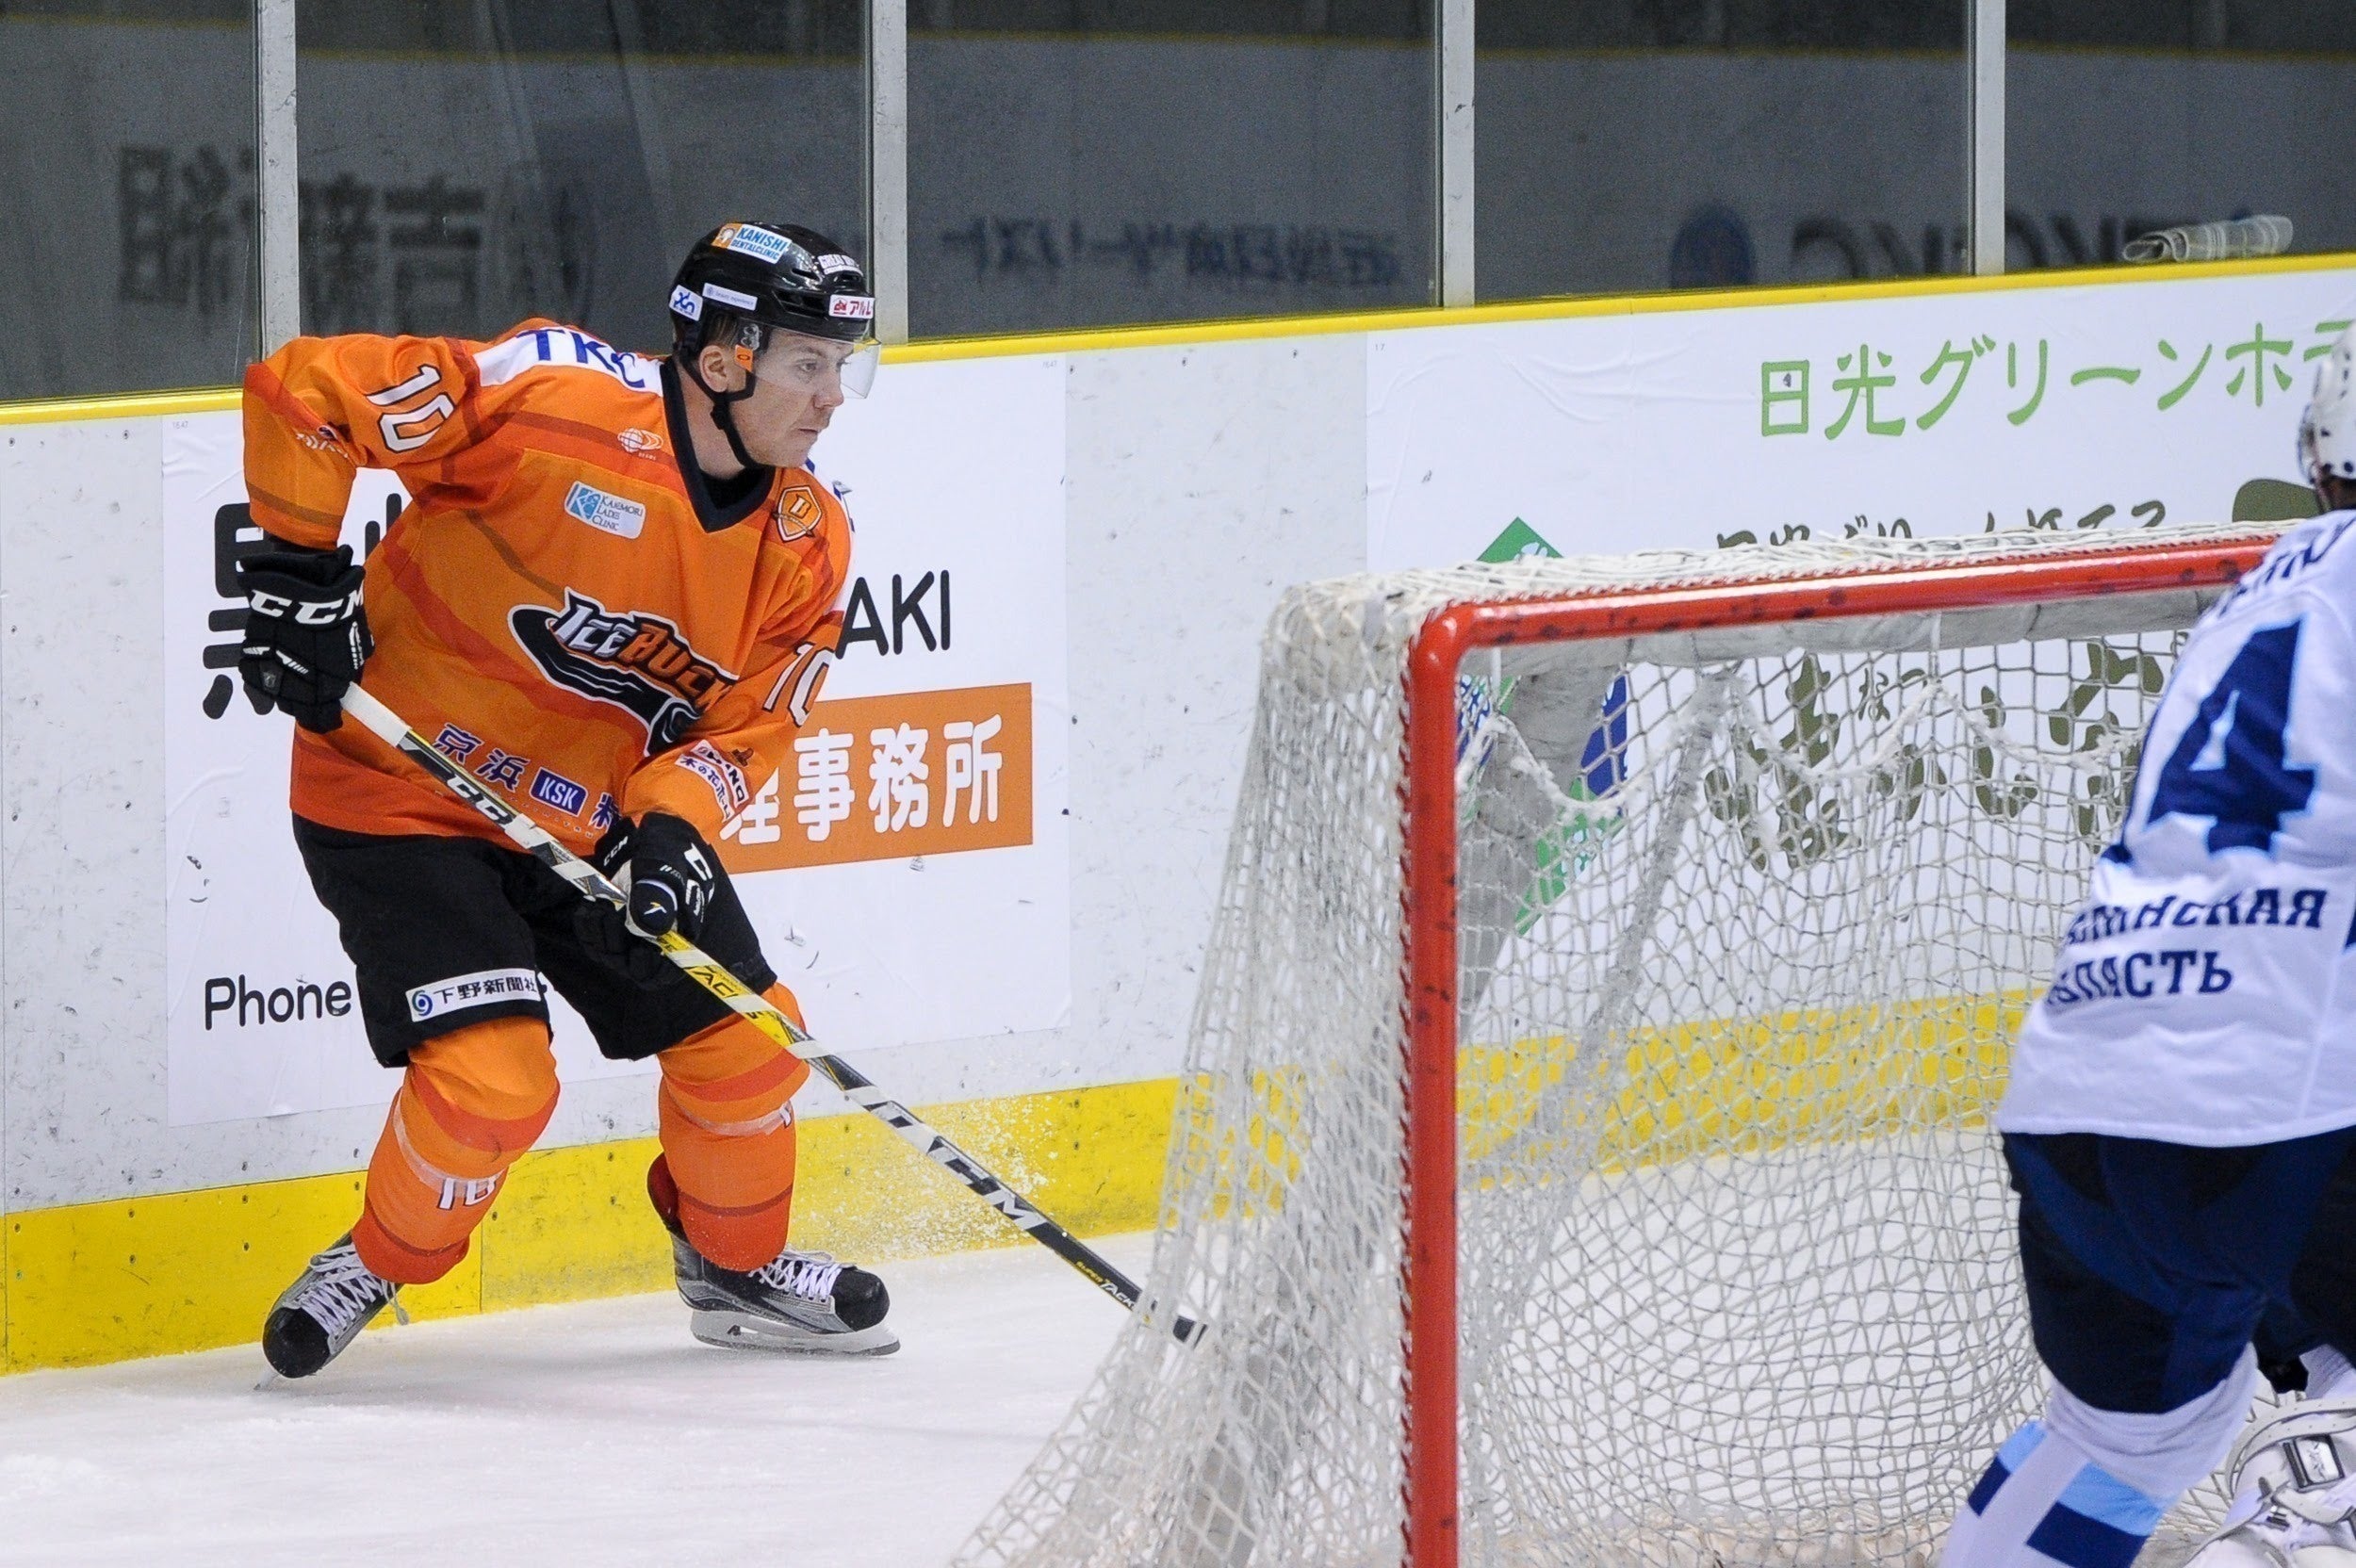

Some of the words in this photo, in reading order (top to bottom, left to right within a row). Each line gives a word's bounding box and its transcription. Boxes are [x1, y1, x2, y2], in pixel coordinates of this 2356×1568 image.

[736, 226, 789, 253] KANISHI
[365, 363, 446, 455] 10
[250, 579, 366, 625] CCM
[835, 569, 951, 660] AKI
[761, 641, 835, 727] 10
[433, 722, 532, 793] 京浜
[537, 776, 581, 810] KSK
[2105, 614, 2320, 861] 4
[205, 974, 352, 1031] Phone
[434, 976, 538, 1004] 下野新聞社
